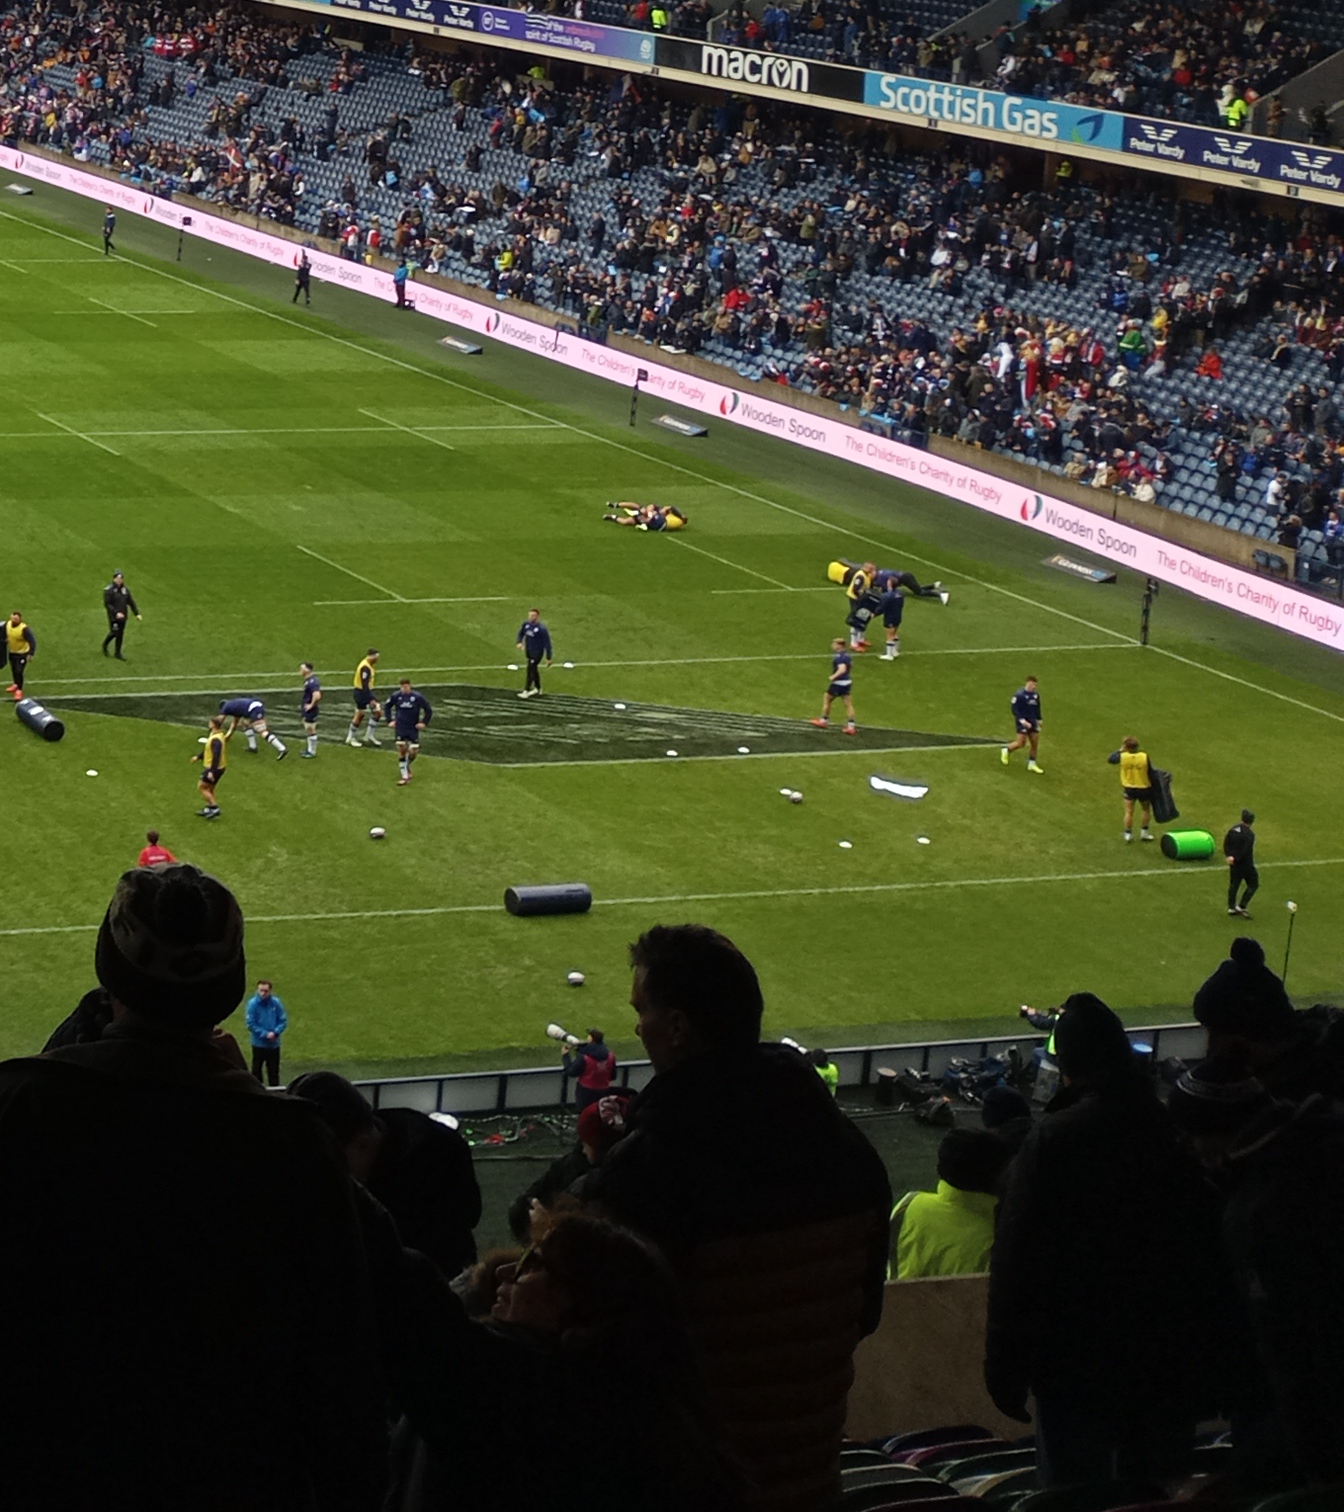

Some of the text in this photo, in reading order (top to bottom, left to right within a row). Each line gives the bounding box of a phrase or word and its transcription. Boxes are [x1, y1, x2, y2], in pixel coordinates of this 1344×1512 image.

[702, 45, 809, 92] macron
[880, 75, 1058, 138] Scottish Gas
[1130, 138, 1185, 160] Peter Vardy
[1203, 150, 1261, 173] Peter Vardy
[1280, 164, 1342, 188] Peter Vardy
[338, 265, 362, 284] Spoon
[502, 323, 568, 356] Wooden Spoon
[581, 348, 596, 363] The
[598, 352, 636, 378] Children's
[678, 380, 705, 402] Rugby
[741, 402, 827, 443] Wooden Spoon
[845, 435, 1002, 504] The Children's Charity of Rugby
[1046, 509, 1138, 558] Wooden Spoon
[1158, 550, 1342, 637] The Children's Charity of Rugby
